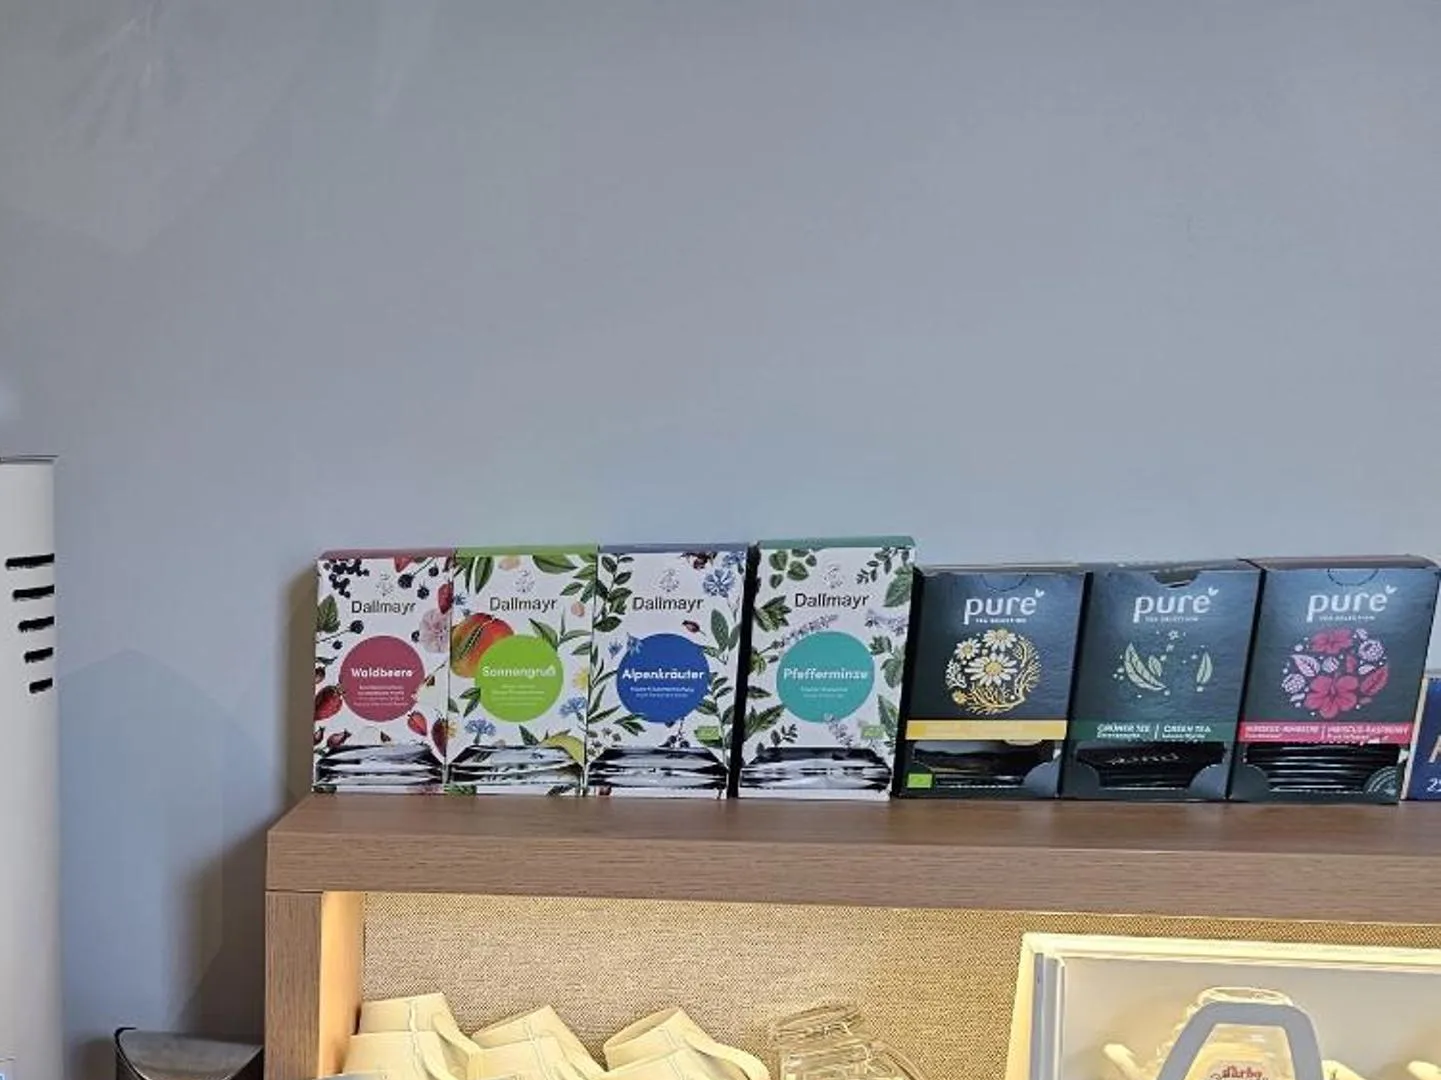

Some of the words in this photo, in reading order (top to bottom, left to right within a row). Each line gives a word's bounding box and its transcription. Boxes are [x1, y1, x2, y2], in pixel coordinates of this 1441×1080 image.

[351, 600, 416, 615] Dallmayr
[489, 597, 558, 612] Dallmayr
[632, 596, 704, 612] Dallmayr
[794, 593, 869, 609] Dallmayr
[1306, 592, 1388, 623] pure
[964, 597, 1037, 625] pure
[1133, 595, 1211, 623] pure
[351, 667, 413, 677] Waldbeere
[622, 667, 705, 682] Alpenkräuter
[783, 667, 868, 680] Pfefferminze
